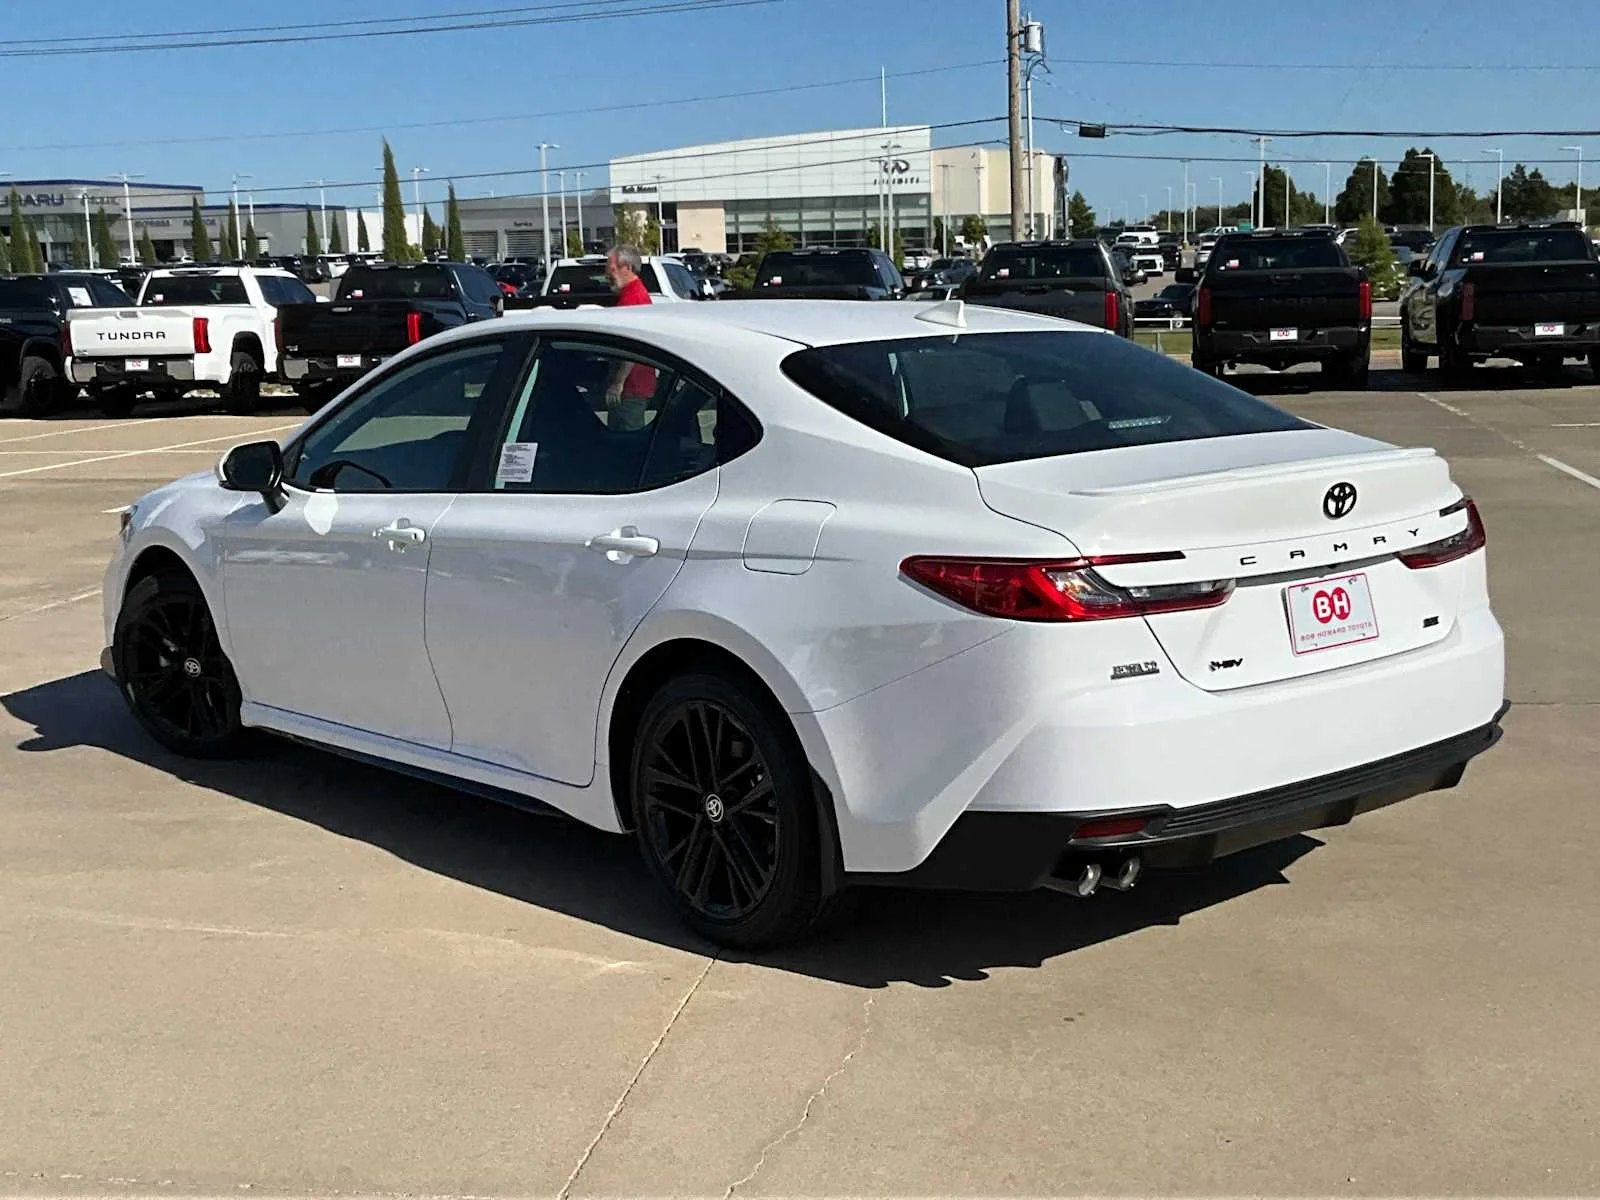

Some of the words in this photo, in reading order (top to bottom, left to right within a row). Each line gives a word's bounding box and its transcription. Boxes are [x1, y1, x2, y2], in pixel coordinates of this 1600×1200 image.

[96, 331, 166, 341] TUNDRA
[1240, 527, 1420, 566] CAMRY
[1314, 591, 1350, 620] BH
[1300, 633, 1315, 641] BOB
[1317, 626, 1346, 638] HOWARD
[1347, 621, 1372, 631] TOYOTA
